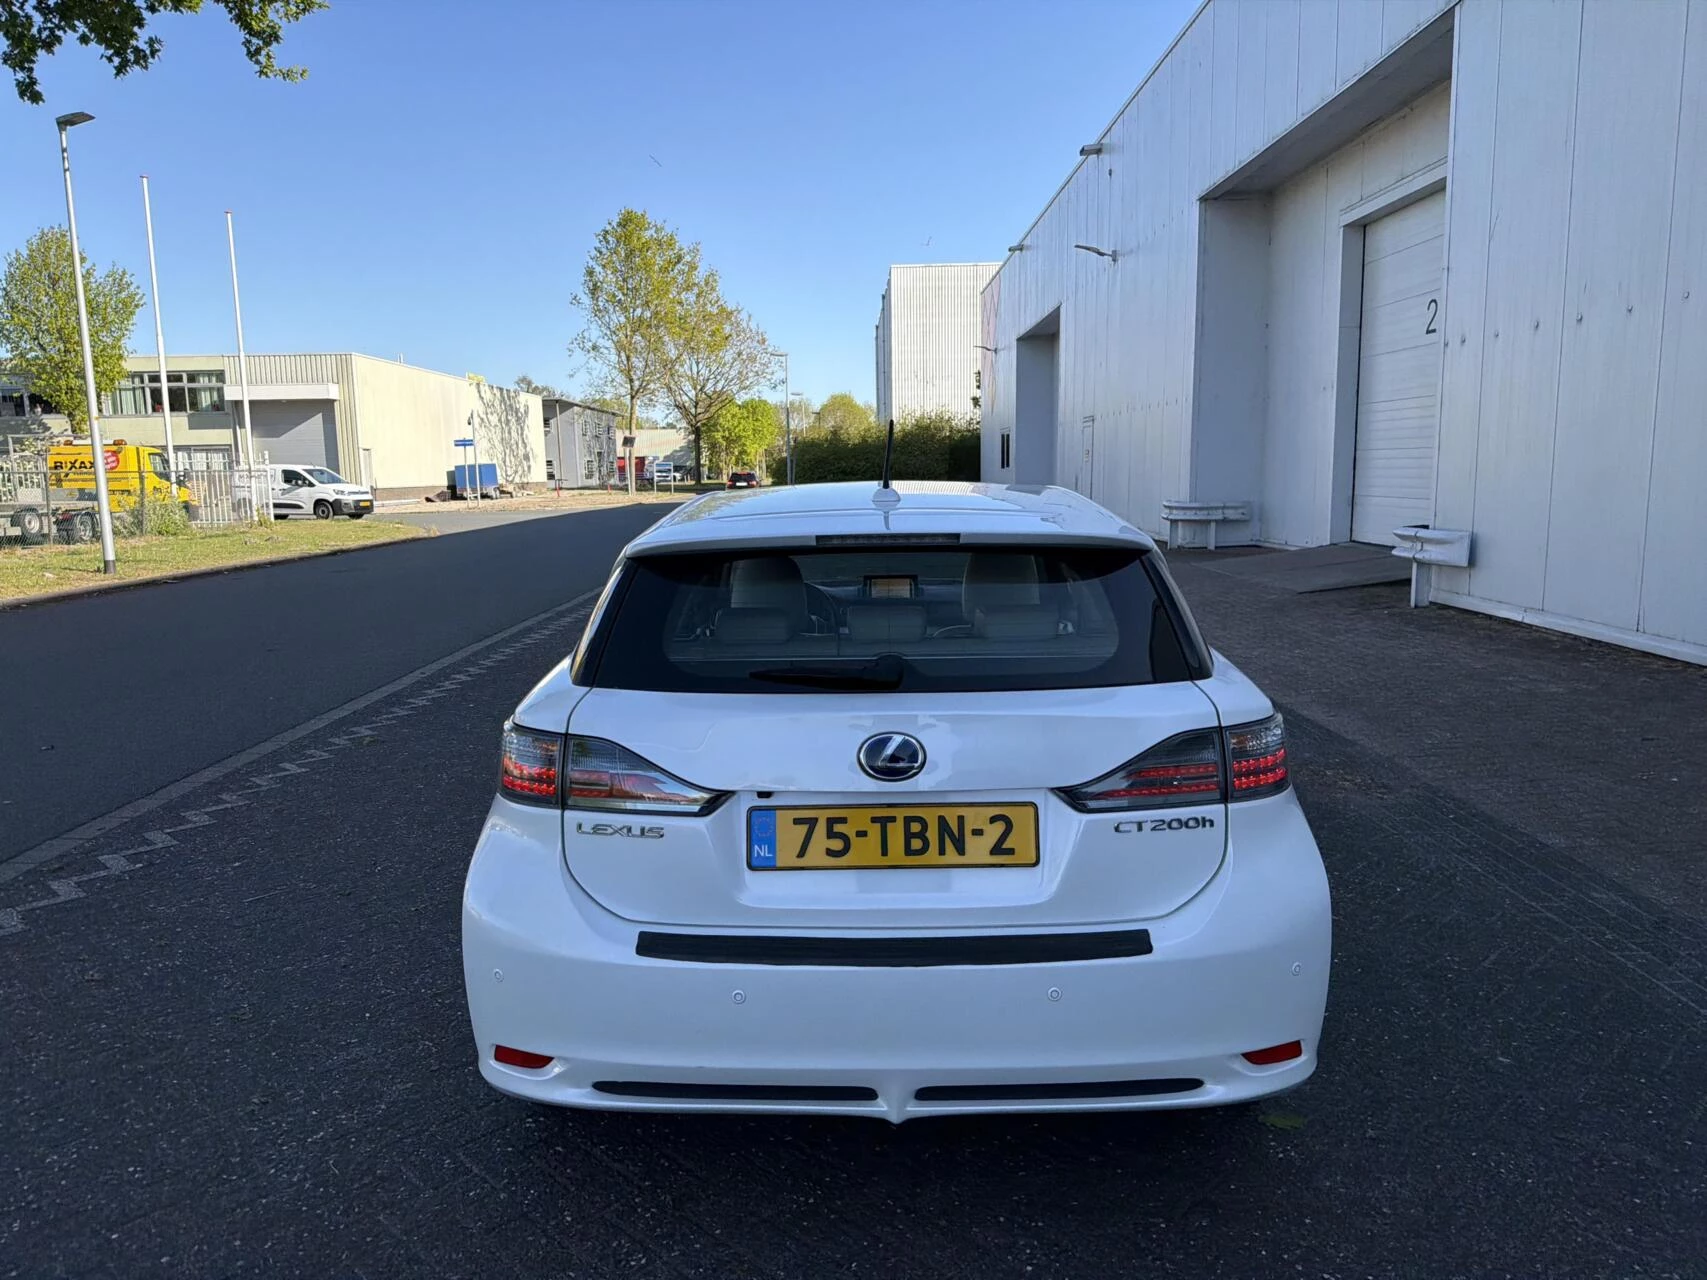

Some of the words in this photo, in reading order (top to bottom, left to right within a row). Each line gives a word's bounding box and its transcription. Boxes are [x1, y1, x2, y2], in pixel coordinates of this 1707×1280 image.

[1425, 298, 1438, 335] 2
[576, 822, 665, 839] LEXUS
[1113, 815, 1216, 833] CT200h
[792, 813, 1016, 859] 75-TBN-2
[754, 844, 773, 858] NL
